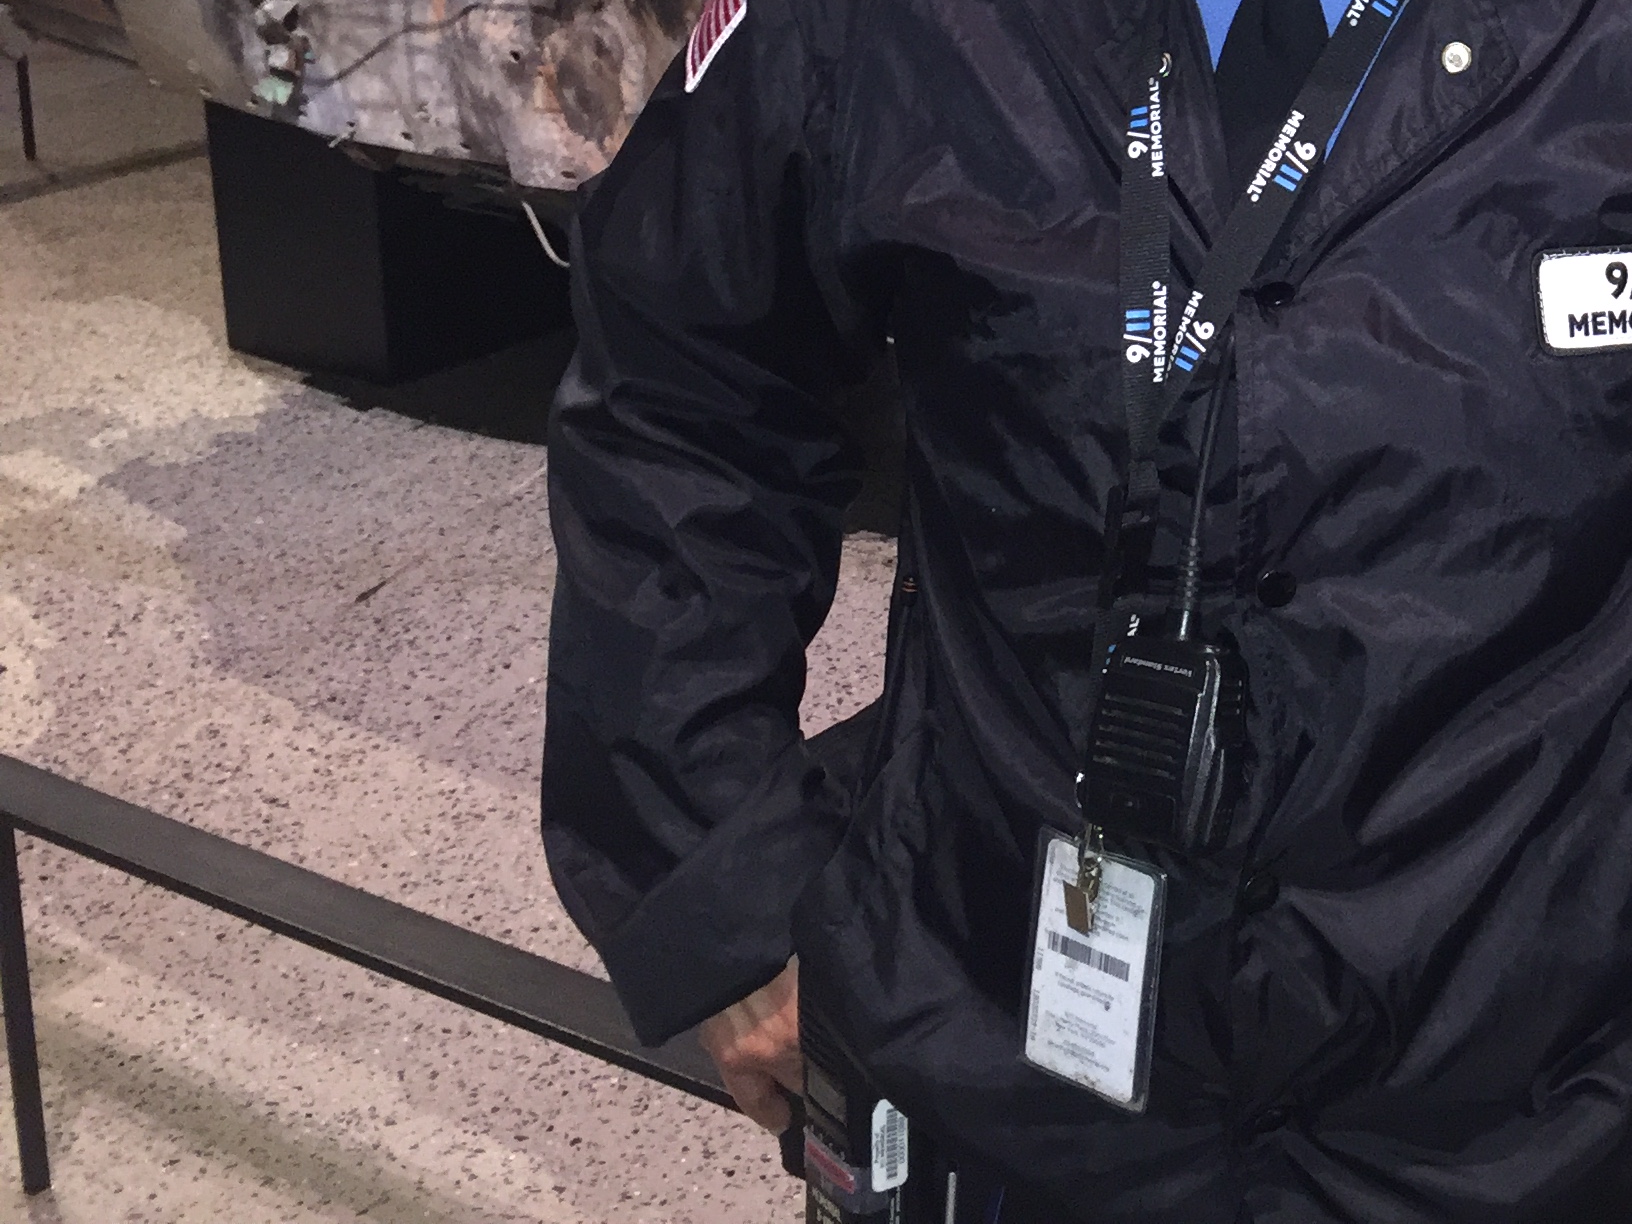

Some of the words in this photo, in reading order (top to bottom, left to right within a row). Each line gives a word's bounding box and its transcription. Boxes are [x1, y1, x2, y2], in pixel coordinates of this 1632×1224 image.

[1127, 106, 1151, 159] 9/11
[1149, 80, 1165, 178] MEMORIAL
[1246, 109, 1305, 195] MEMORIAL
[1273, 140, 1317, 192] 9/11
[1123, 309, 1153, 364] 9/11
[1152, 285, 1167, 383] MEMORIAL
[1174, 321, 1216, 372] 9/11
